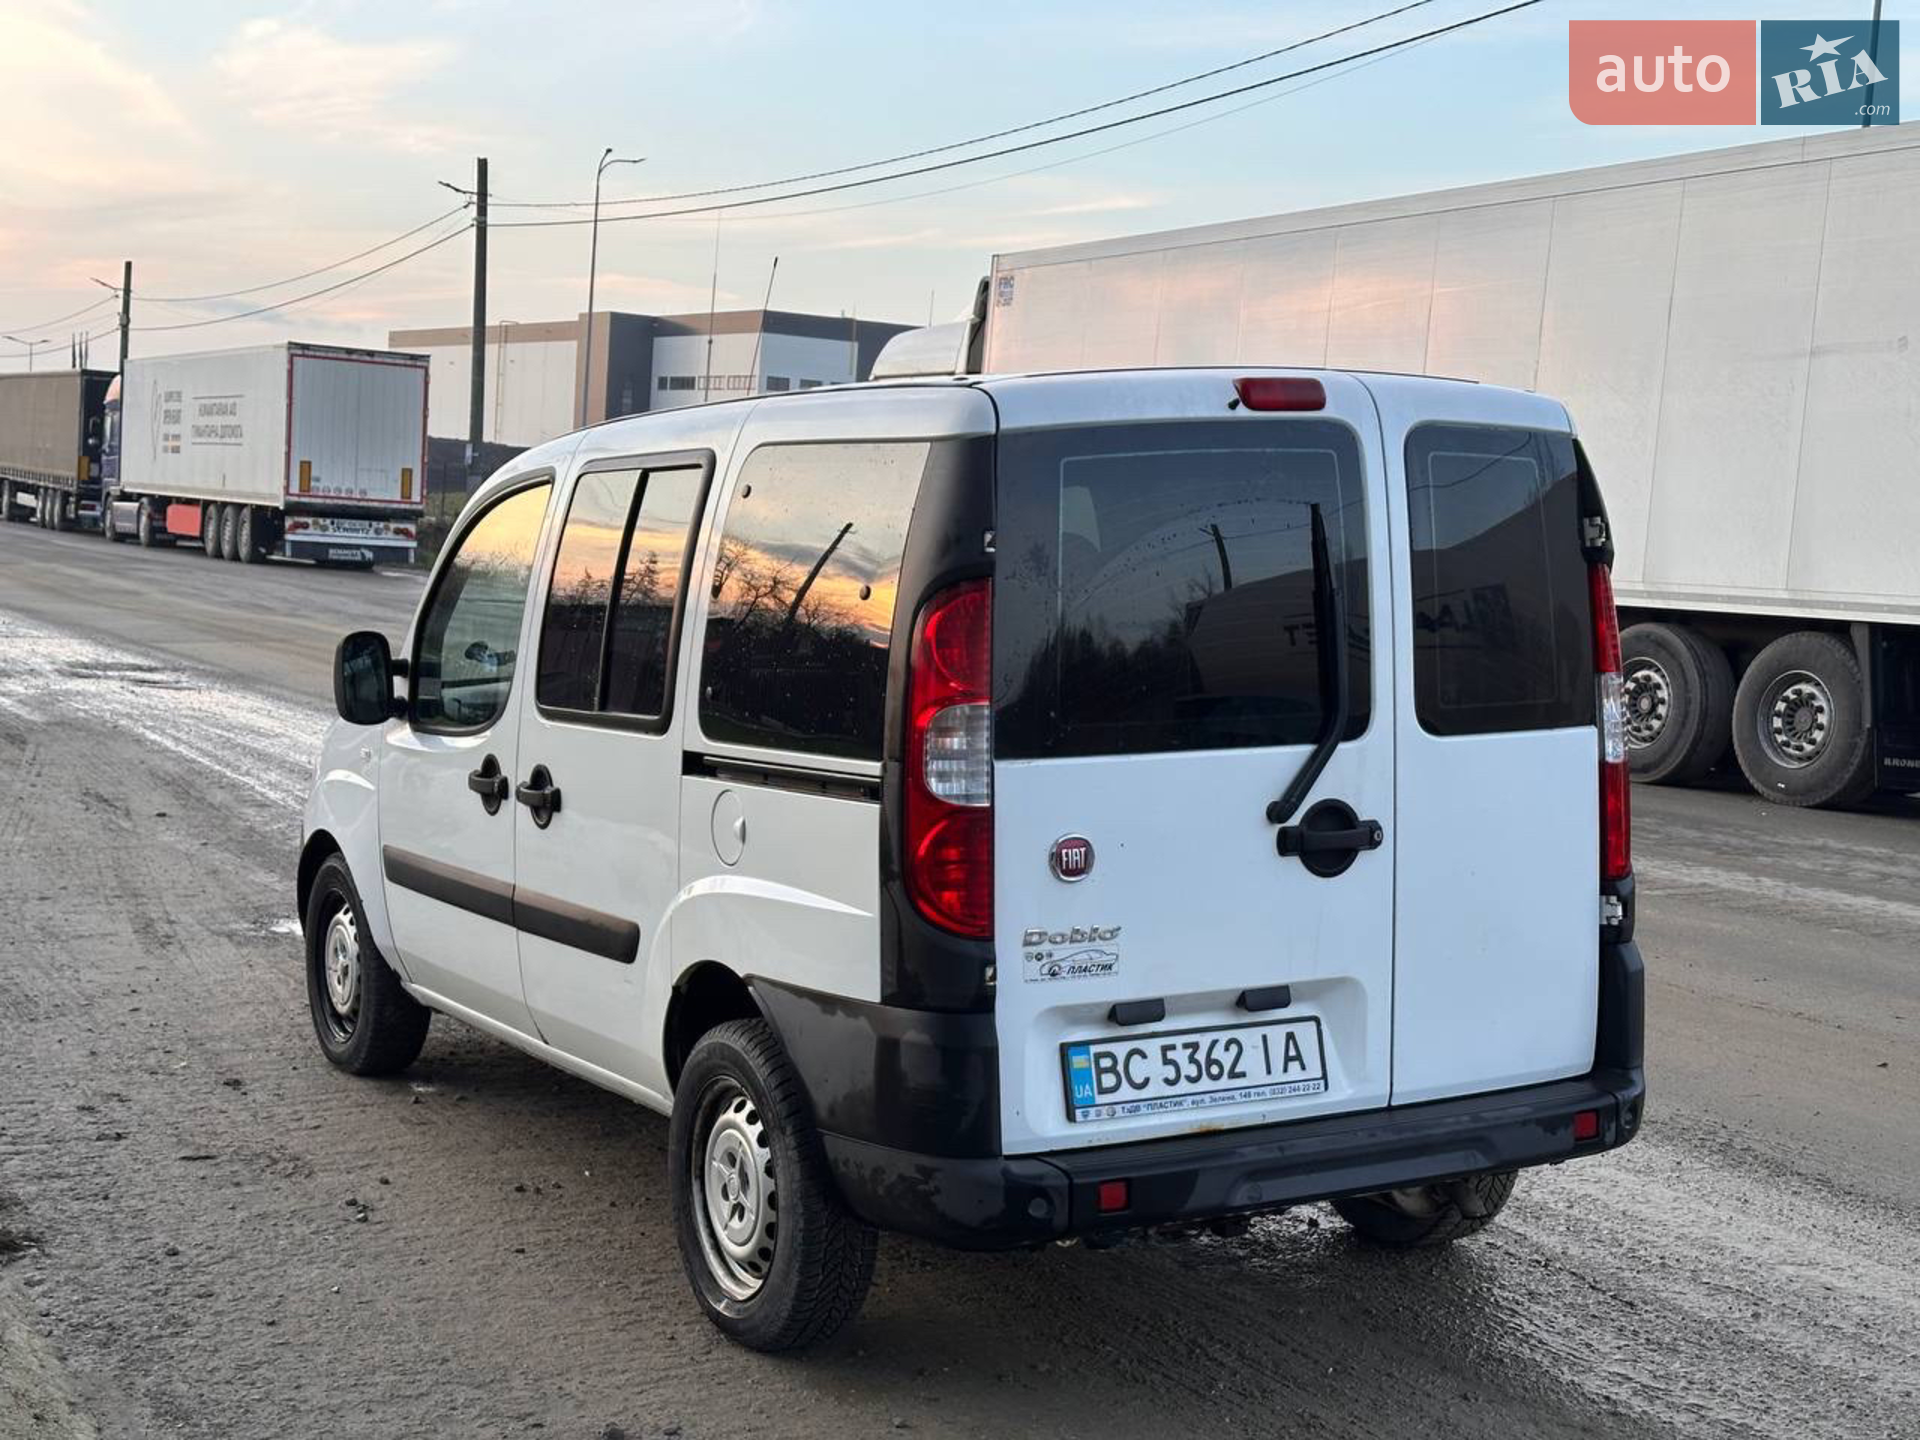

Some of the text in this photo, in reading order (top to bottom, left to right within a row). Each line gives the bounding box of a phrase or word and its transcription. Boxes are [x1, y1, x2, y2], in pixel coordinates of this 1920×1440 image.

[1061, 847, 1087, 869] FIAT
[1066, 962, 1116, 976] ПЛАСТИК
[1093, 1031, 1307, 1096] BC 5362 IA
[1074, 1084, 1093, 1099] UA
